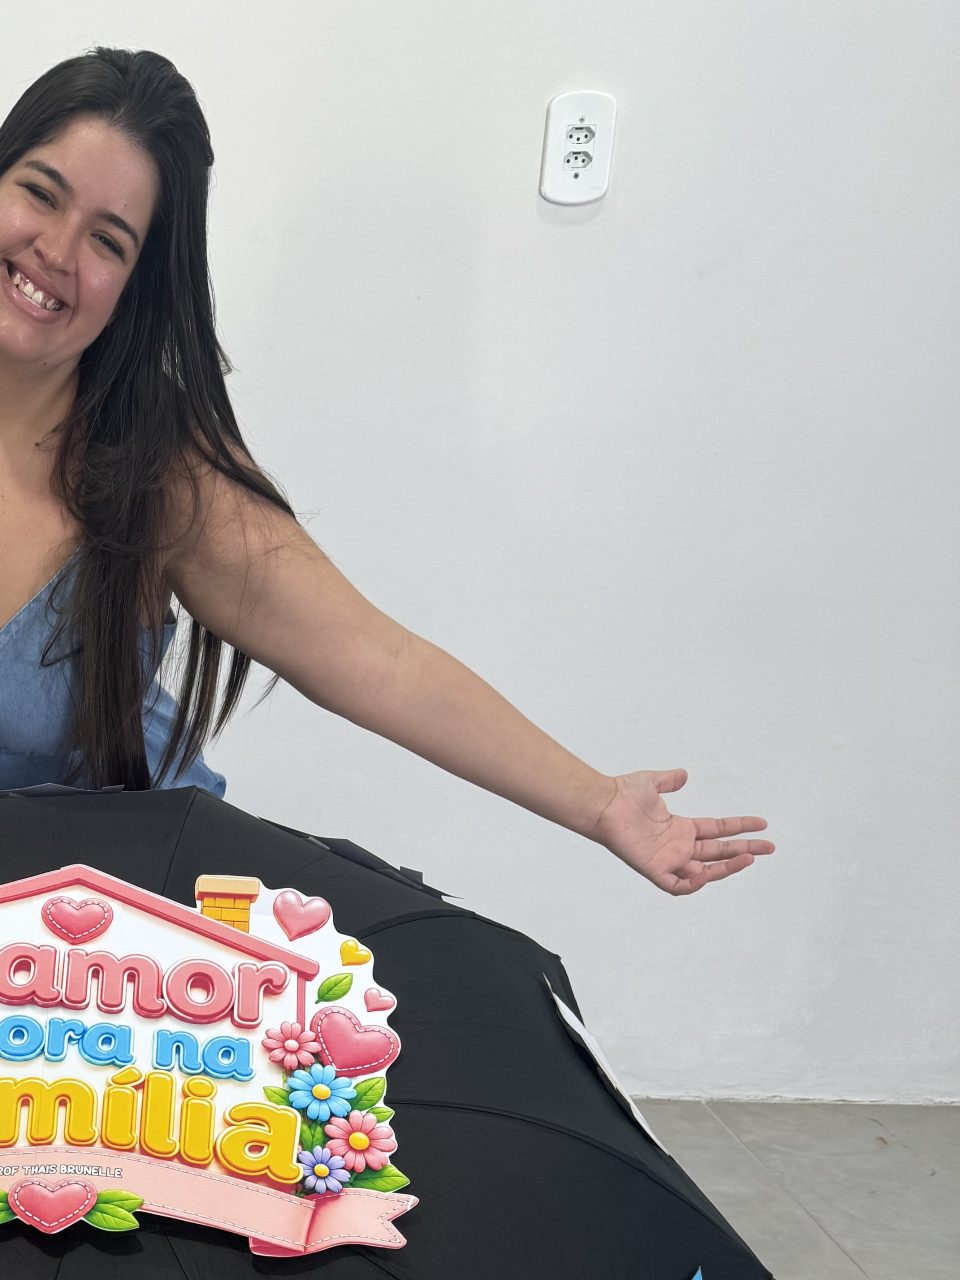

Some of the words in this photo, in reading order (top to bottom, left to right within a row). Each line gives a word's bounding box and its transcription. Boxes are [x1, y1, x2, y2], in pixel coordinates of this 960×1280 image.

[156, 1030, 254, 1079] na
[22, 1165, 57, 1175] THAIS
[60, 1164, 123, 1178] BRUNELLE
